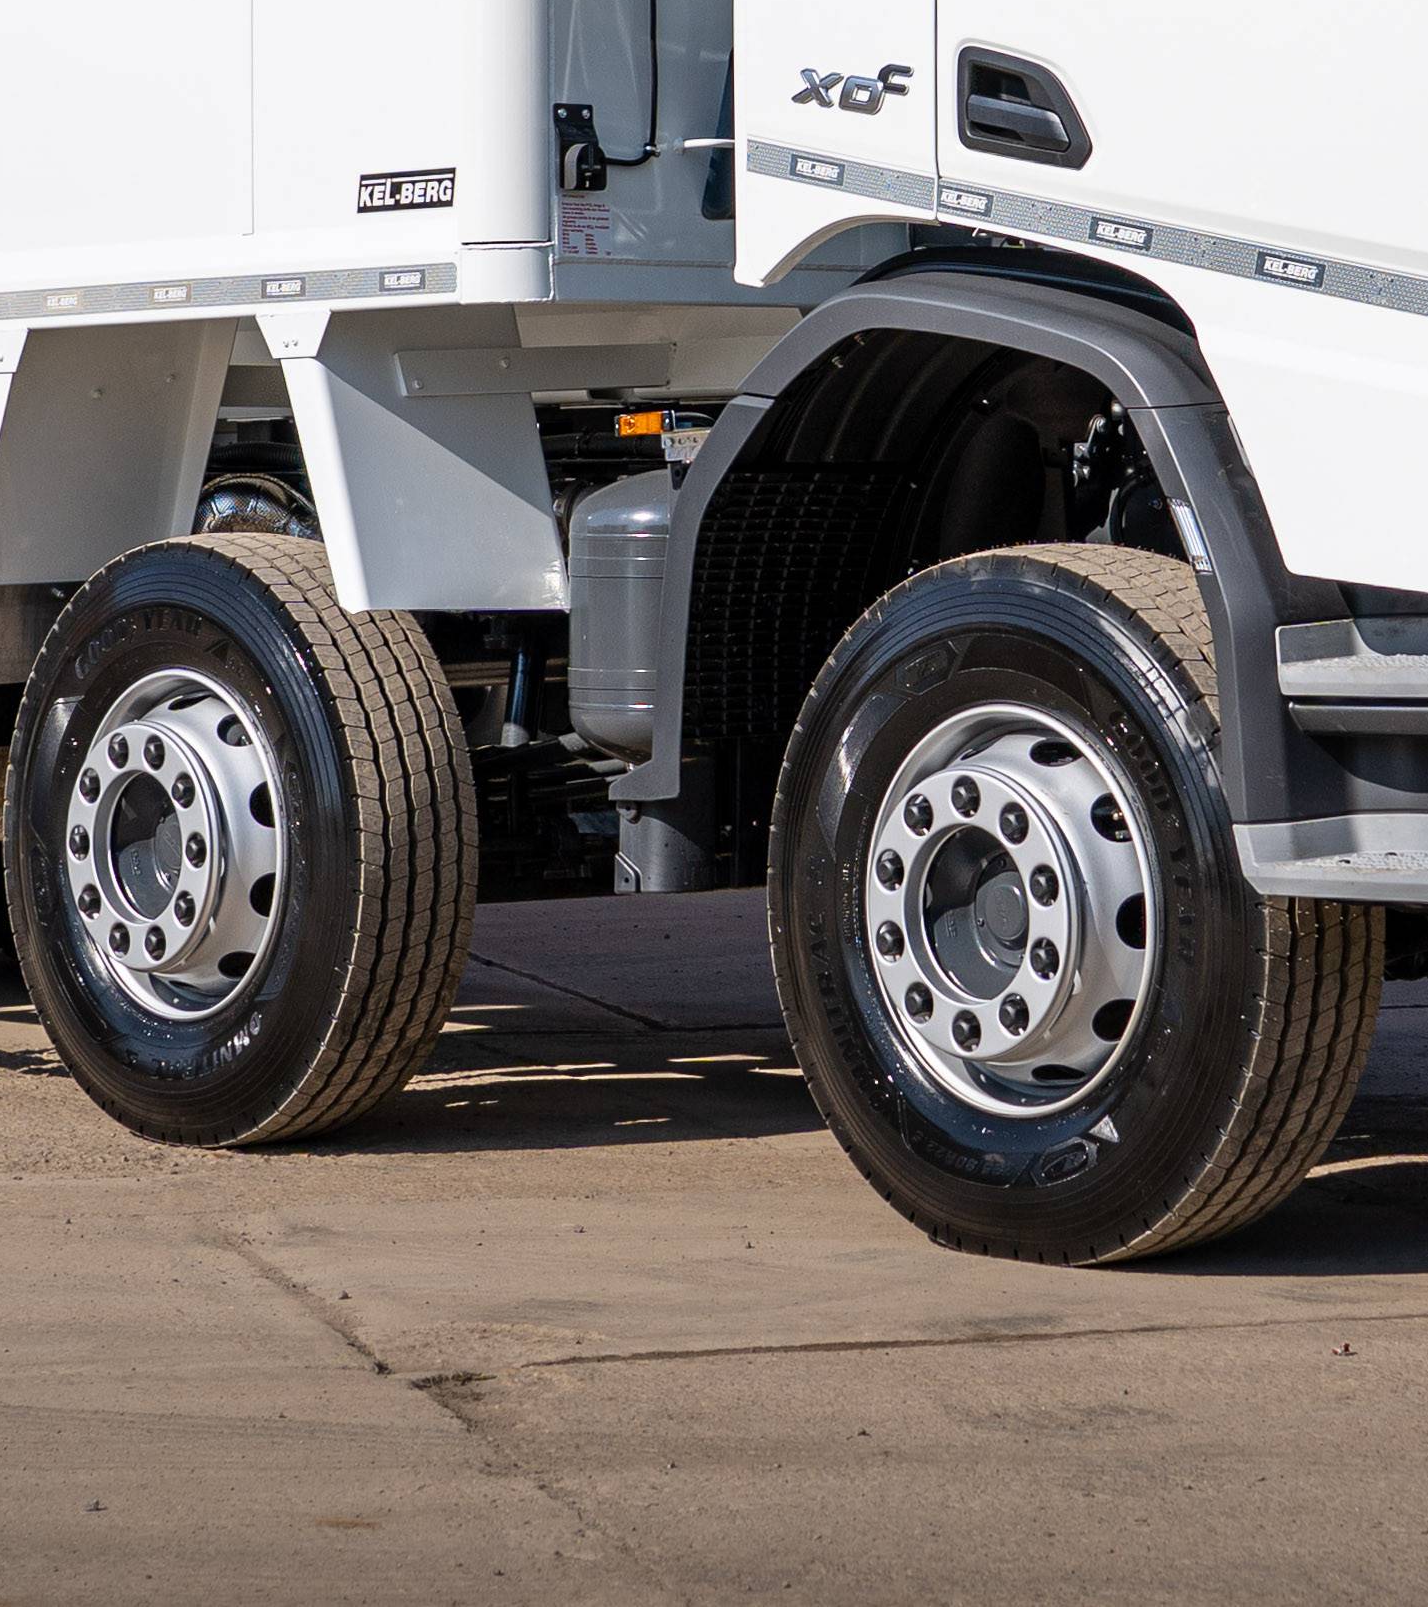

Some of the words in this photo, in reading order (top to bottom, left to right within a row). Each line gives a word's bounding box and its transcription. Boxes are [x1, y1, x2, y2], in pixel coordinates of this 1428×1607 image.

[796, 159, 840, 178] KEL-BERG
[359, 179, 452, 207] KEL-BERG
[941, 188, 989, 209] KEL-BERG
[1096, 222, 1147, 244] KEL-BERG
[1264, 257, 1319, 279] KEL-BERG
